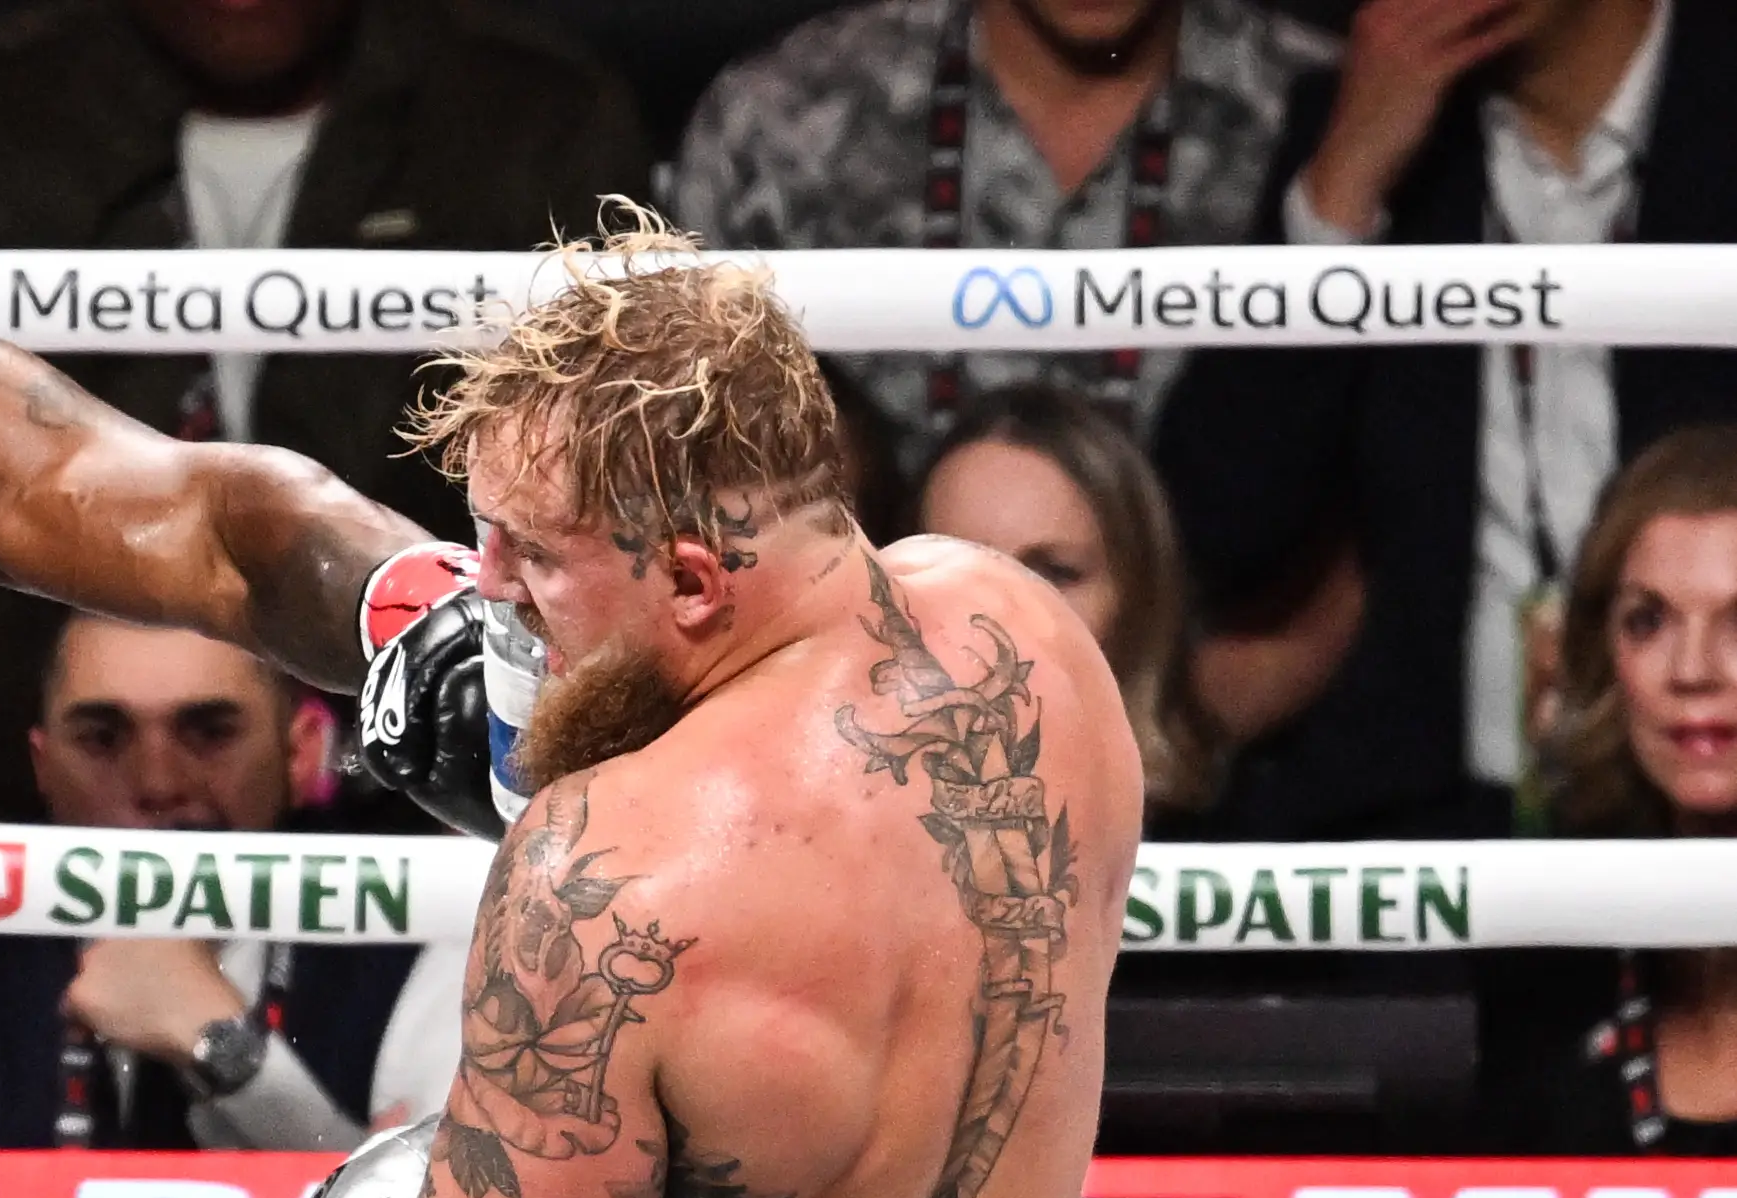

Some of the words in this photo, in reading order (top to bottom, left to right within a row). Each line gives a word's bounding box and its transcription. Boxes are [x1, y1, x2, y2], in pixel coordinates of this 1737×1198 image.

[10, 270, 224, 334] Meta
[246, 271, 498, 334] Quest
[1075, 268, 1289, 330] Meta
[1309, 267, 1563, 334] Quest
[50, 847, 411, 934] SPATEN
[1122, 866, 1470, 943] SPATEN
